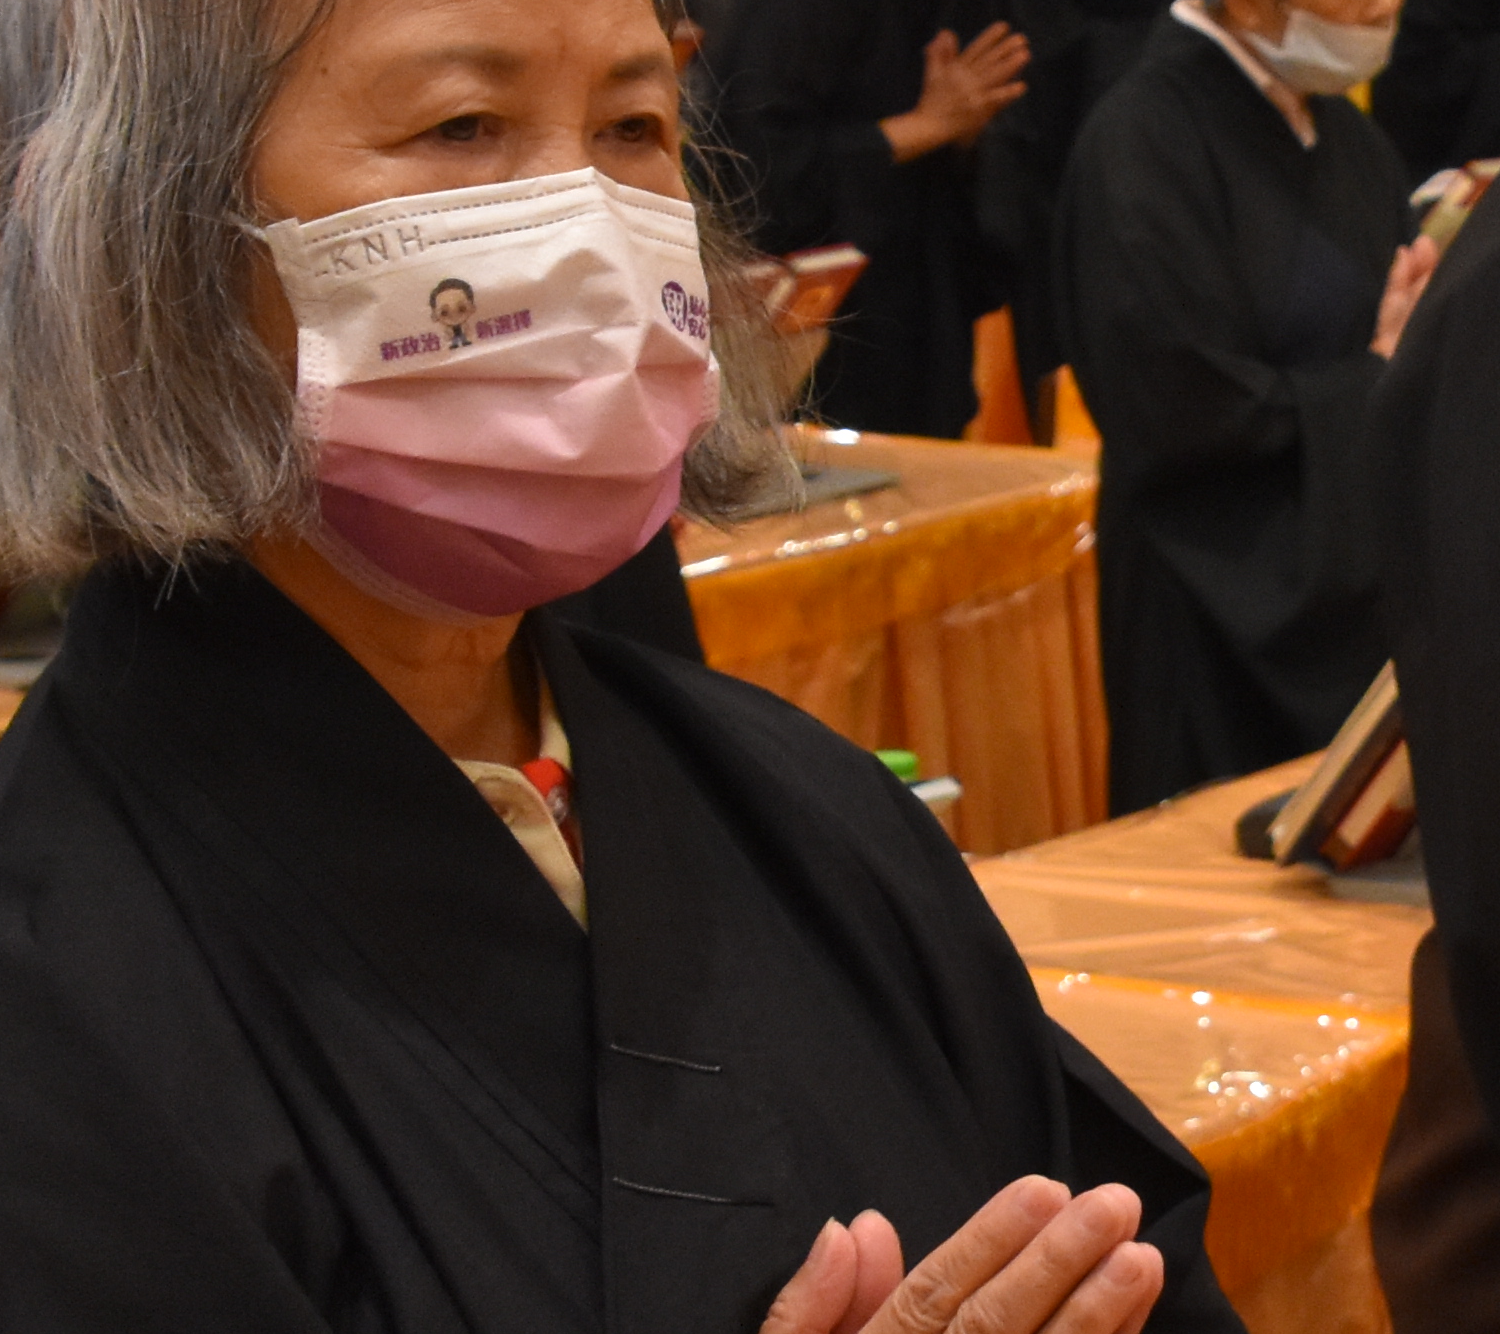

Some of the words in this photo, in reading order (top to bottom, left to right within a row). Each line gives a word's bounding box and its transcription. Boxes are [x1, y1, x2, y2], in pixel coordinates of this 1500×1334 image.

[329, 224, 425, 275] KNH
[380, 331, 442, 361] 新政治
[475, 309, 533, 340] 新選擇
